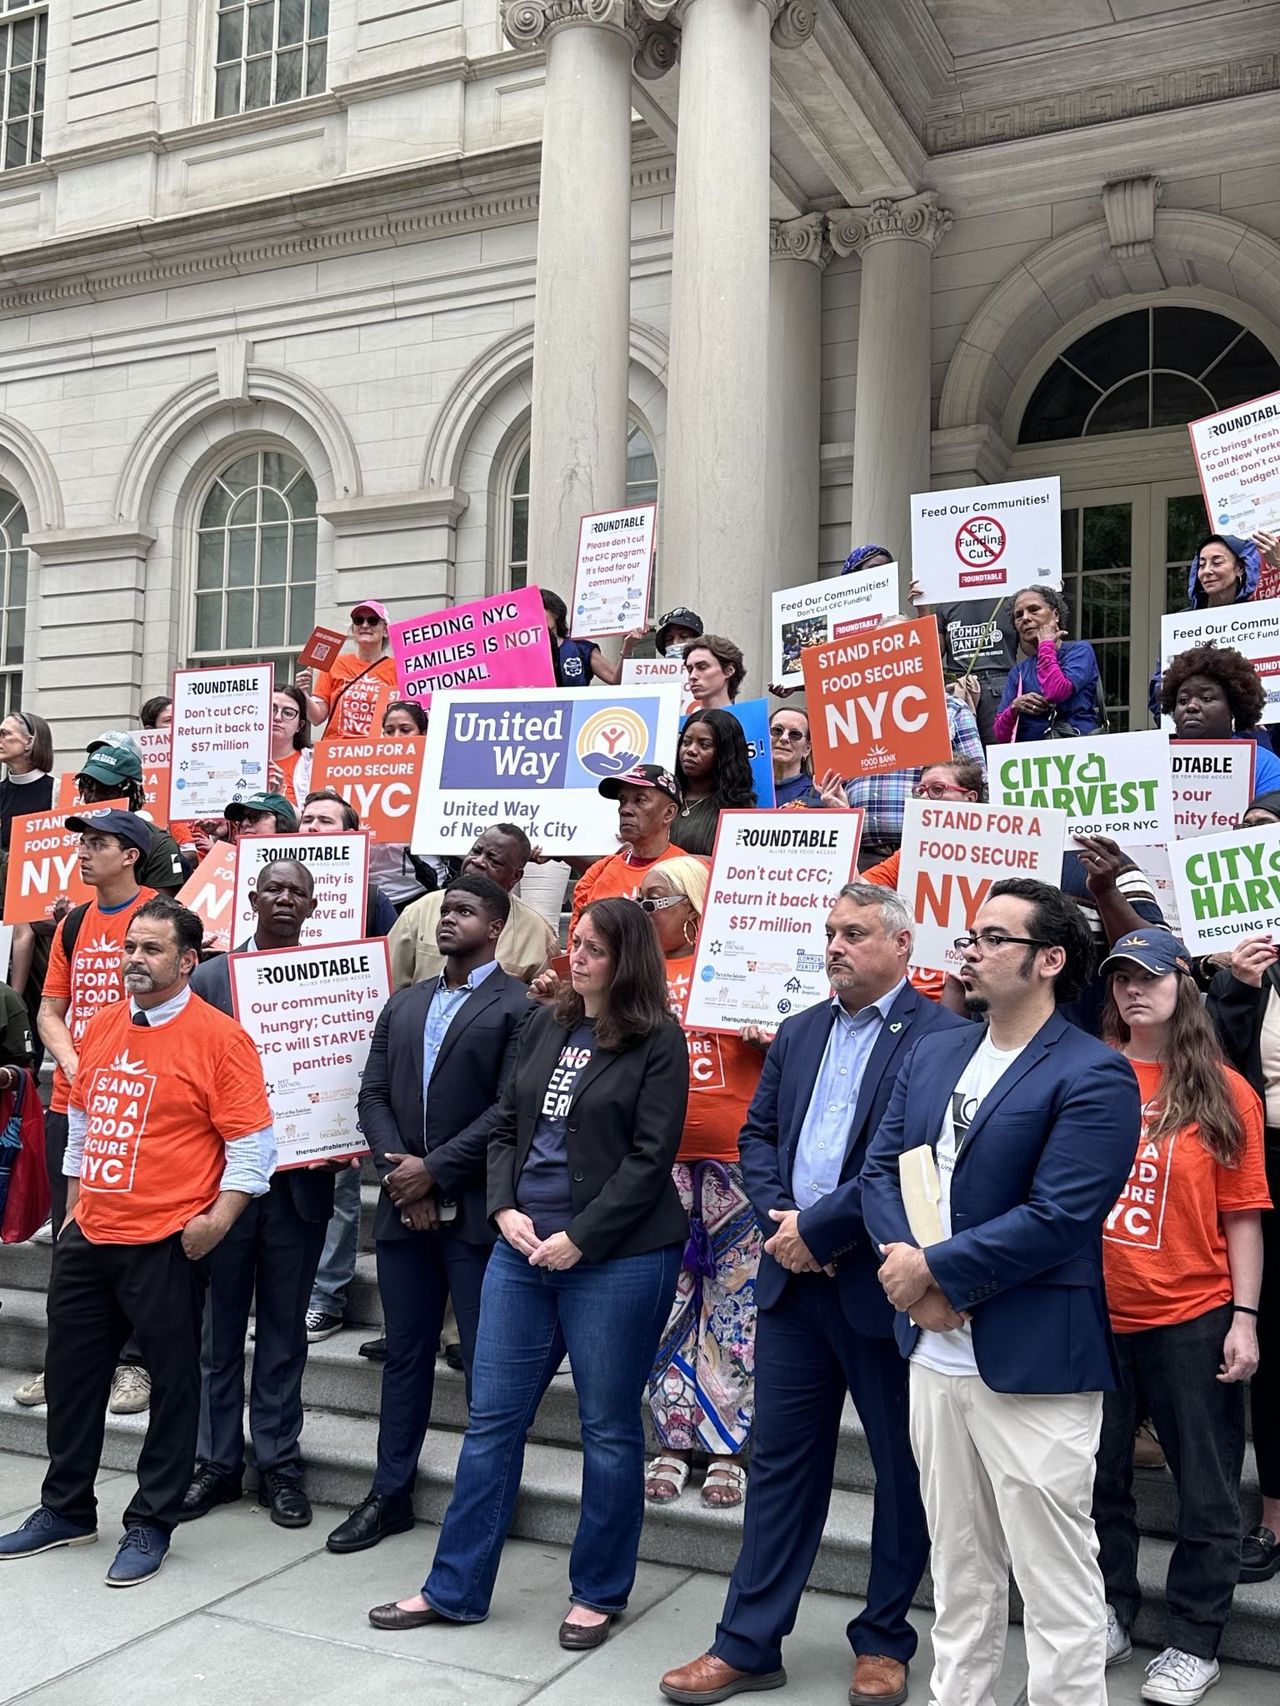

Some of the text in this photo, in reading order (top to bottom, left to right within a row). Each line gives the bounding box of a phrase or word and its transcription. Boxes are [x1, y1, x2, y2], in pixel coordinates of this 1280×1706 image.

[1212, 405, 1280, 436] ROUNDTABL
[1201, 449, 1220, 460] CFC
[1221, 437, 1252, 454] brings
[1206, 451, 1252, 471] to all New
[1241, 458, 1267, 473] Don't
[1240, 467, 1279, 486] budget!
[922, 494, 1050, 518] Feed Our Communities!
[593, 516, 645, 533] ROUNDTABLE
[970, 522, 992, 534] CFC
[587, 535, 645, 550] Please don't cut
[959, 535, 1004, 547] Funding
[595, 553, 609, 561] CFC
[969, 549, 994, 559] Cuts
[597, 564, 614, 573] food
[615, 563, 626, 571] for
[589, 575, 634, 587] community!
[964, 572, 1003, 583] ROUNDTABLE
[781, 578, 889, 612] Feed Our Communities!
[797, 594, 872, 617] Don't Cut CFC Funding!
[403, 603, 519, 646] FEEDING NYC
[1173, 625, 1228, 639] Feed Our
[1220, 633, 1255, 644] Cut CFC
[404, 627, 542, 673] FAMILIES IS NOT
[818, 630, 921, 669] STAND FOR A
[635, 664, 678, 675] STAND
[822, 656, 924, 695] FOOD SECURE
[191, 678, 259, 695] ROUNDTABLE
[406, 665, 491, 697] OPTIONAL.
[344, 690, 367, 701] FOR
[184, 705, 258, 719] Don't cut CFC;
[825, 685, 929, 749] NYC
[178, 722, 264, 736] Return it back to
[454, 709, 562, 742] United
[191, 740, 249, 752] $57 million
[328, 743, 416, 759] STAND FOR A
[493, 746, 560, 784] Way
[861, 757, 878, 767] FOOD
[879, 753, 897, 764] BANK
[1172, 757, 1232, 773] DTABLE
[326, 763, 414, 778] FOOD SECURE
[1000, 753, 1075, 790] CITY
[1002, 780, 1158, 818] HARVEST
[1182, 790, 1212, 802] our
[443, 801, 540, 821] United Way
[1211, 811, 1239, 826] fed
[440, 821, 458, 837] of
[544, 822, 577, 841] City
[921, 808, 1042, 837] STAND FOR A
[1068, 819, 1159, 836] FOOD FOR NYC
[24, 837, 60, 853] FOOD
[742, 829, 839, 848] ROUNDTABLE
[262, 846, 350, 863] ROUNDTABLE
[919, 841, 1039, 870] FOOD SECURE
[1185, 843, 1265, 886] CITY
[21, 852, 83, 897] NY
[344, 873, 354, 884] is
[727, 865, 833, 885] Don't cut CFC;
[714, 891, 838, 909] Return it back to
[914, 871, 993, 931] NY
[340, 909, 354, 919] all
[729, 915, 812, 934] $57 million
[1198, 921, 1264, 939] RESCUING
[76, 957, 120, 970] STAND
[264, 956, 370, 985] ROUNDTABLE
[76, 972, 120, 987] FOR A
[76, 989, 120, 1003] FOOD
[251, 987, 378, 1014] Our community is
[260, 1009, 374, 1034] hungry; Cutting
[255, 1029, 366, 1055] CFC will STARVE
[293, 1053, 353, 1075] pantries
[96, 1077, 146, 1097] SAND
[122, 1101, 138, 1119] A
[296, 1139, 366, 1156] theroundtablenyc.org
[1141, 1142, 1159, 1160] A
[1106, 1203, 1152, 1236] YC
